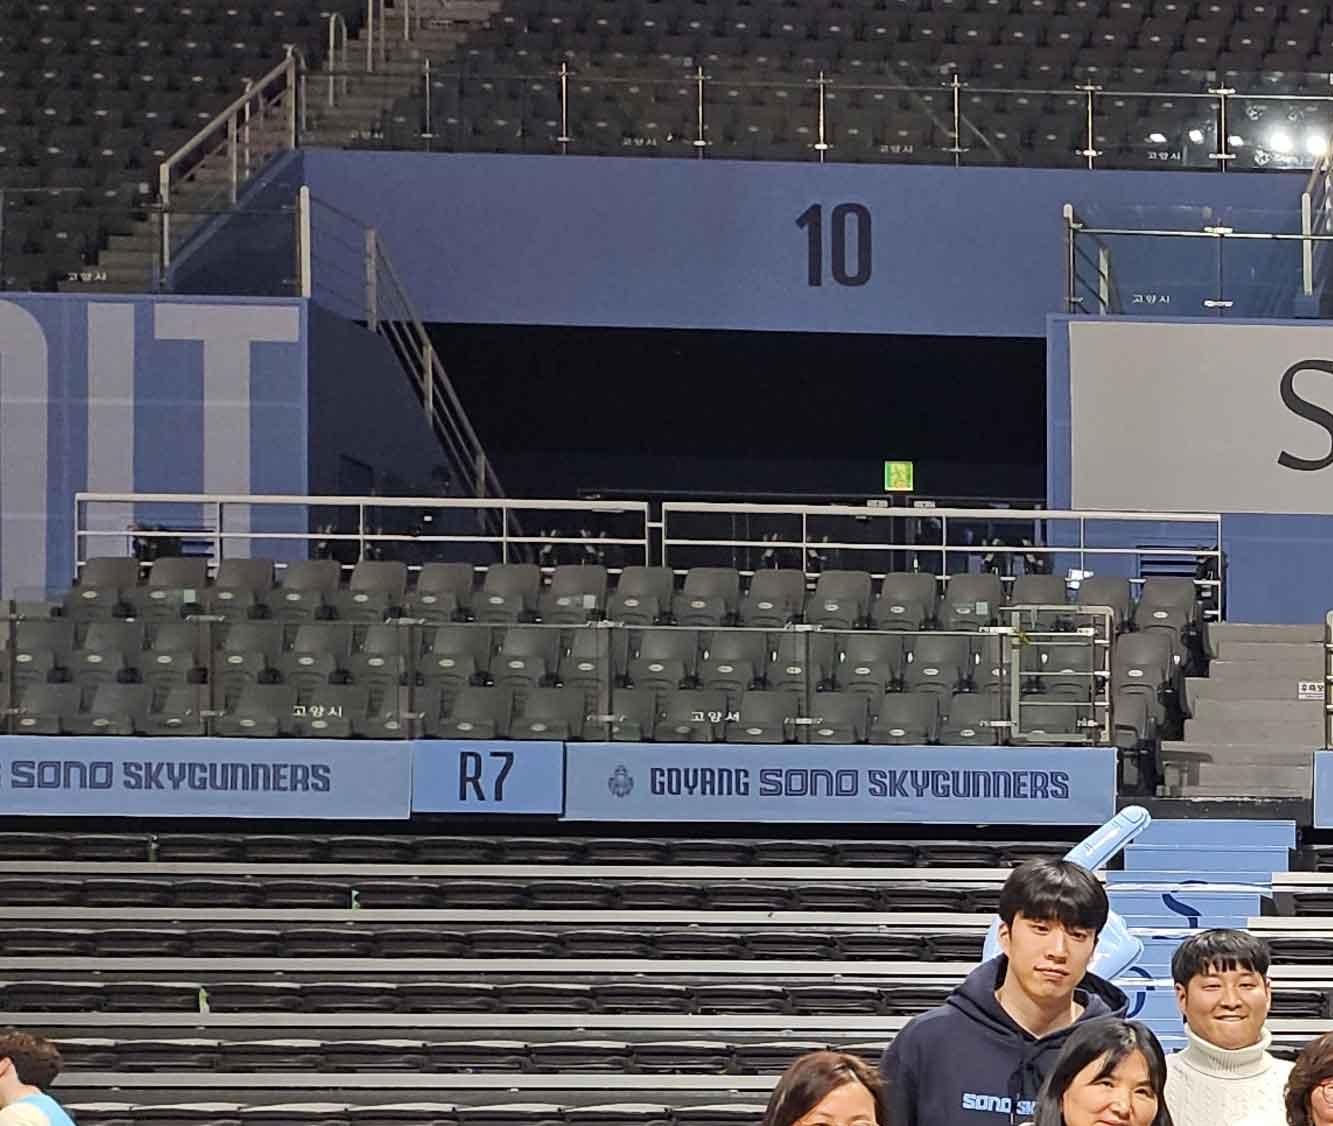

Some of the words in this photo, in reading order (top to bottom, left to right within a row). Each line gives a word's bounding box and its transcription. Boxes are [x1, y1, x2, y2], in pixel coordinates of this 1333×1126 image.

[795, 203, 872, 286] 10
[293, 705, 343, 718] 고양시
[123, 762, 331, 792] SKYGUNNERS
[459, 752, 515, 801] R7
[650, 767, 750, 797] GOYANG
[868, 770, 1069, 799] SKYGUNNERS
